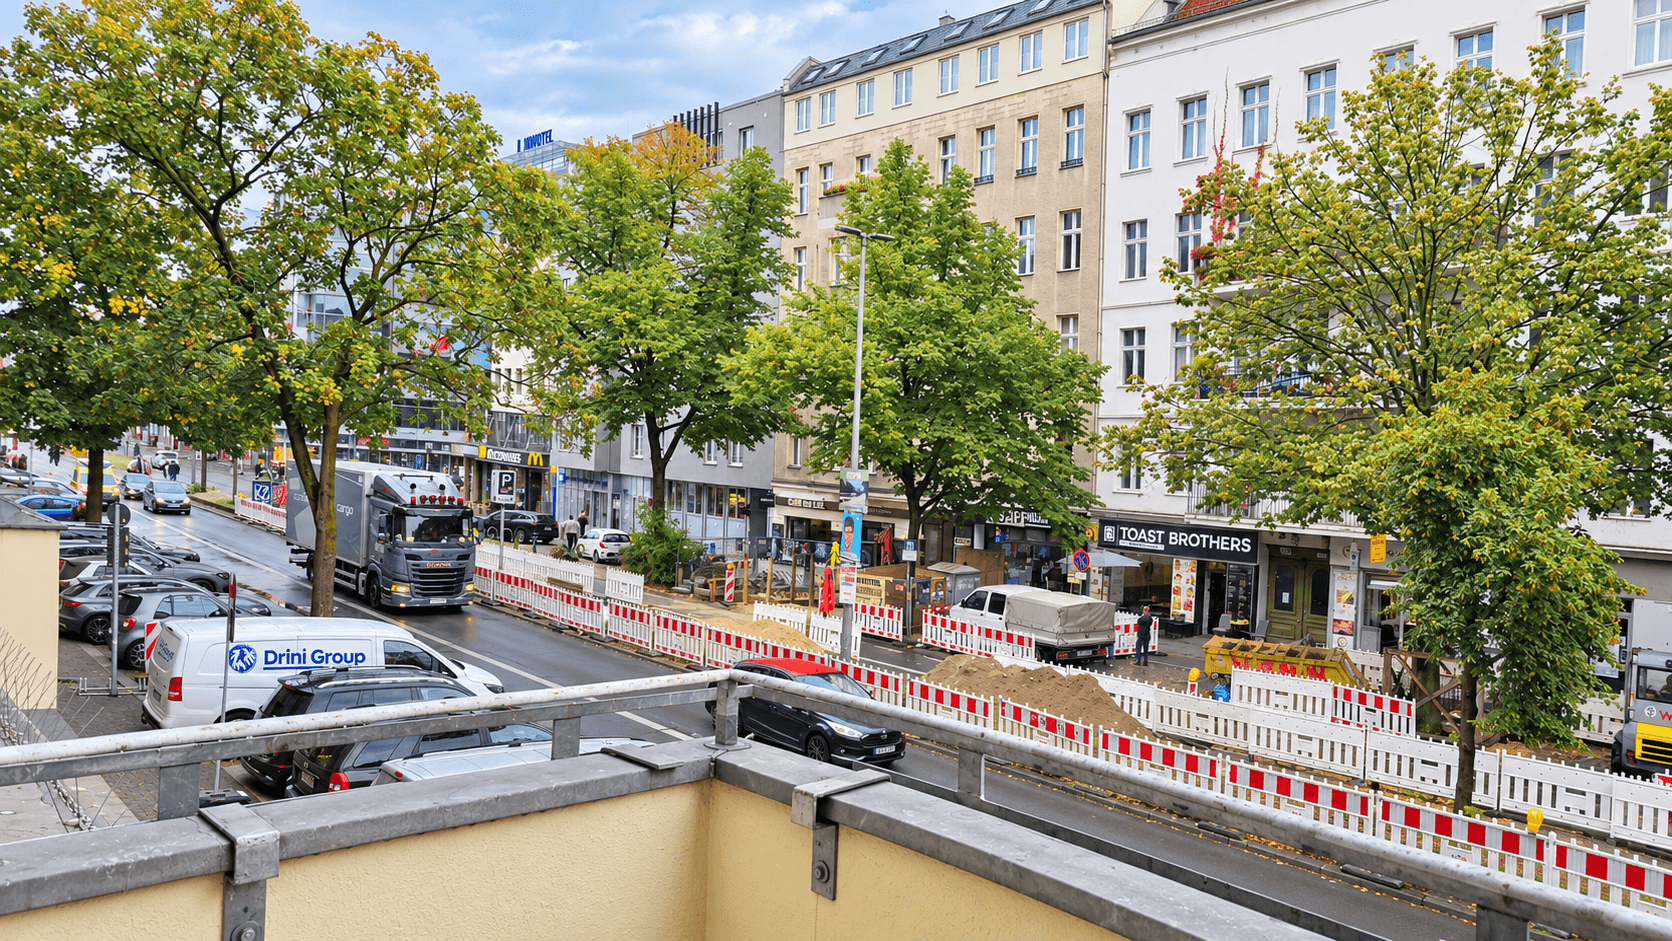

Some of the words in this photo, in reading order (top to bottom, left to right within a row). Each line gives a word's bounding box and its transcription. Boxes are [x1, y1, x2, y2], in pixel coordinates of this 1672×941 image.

[502, 474, 512, 487] P
[1119, 527, 1165, 544] TOAST
[1168, 531, 1252, 553] BROTHERS
[264, 648, 307, 665] Drini
[310, 649, 367, 666] Group
